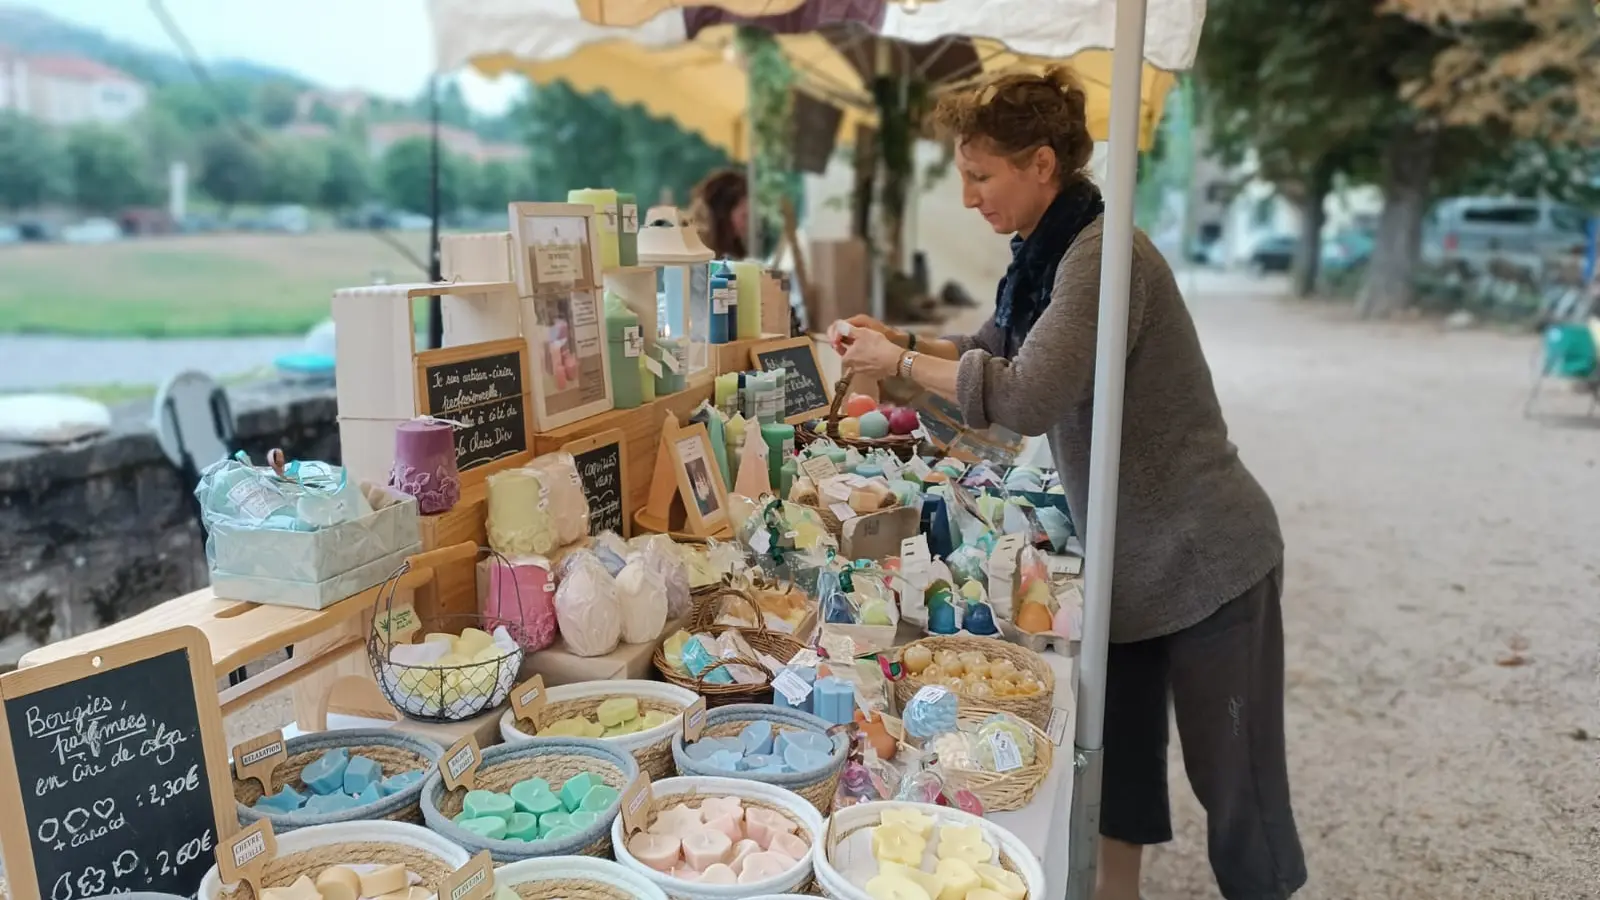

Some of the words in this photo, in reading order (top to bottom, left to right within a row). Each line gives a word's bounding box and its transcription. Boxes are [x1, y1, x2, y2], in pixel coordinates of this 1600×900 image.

[432, 372, 443, 388] Je
[507, 404, 518, 417] de
[494, 427, 513, 445] Dieu
[244, 743, 281, 763] RELAXATION
[35, 775, 69, 796] en
[72, 759, 106, 782] cire
[111, 742, 136, 767] de
[149, 764, 200, 806] 2,30€
[156, 829, 212, 876] 2,60€
